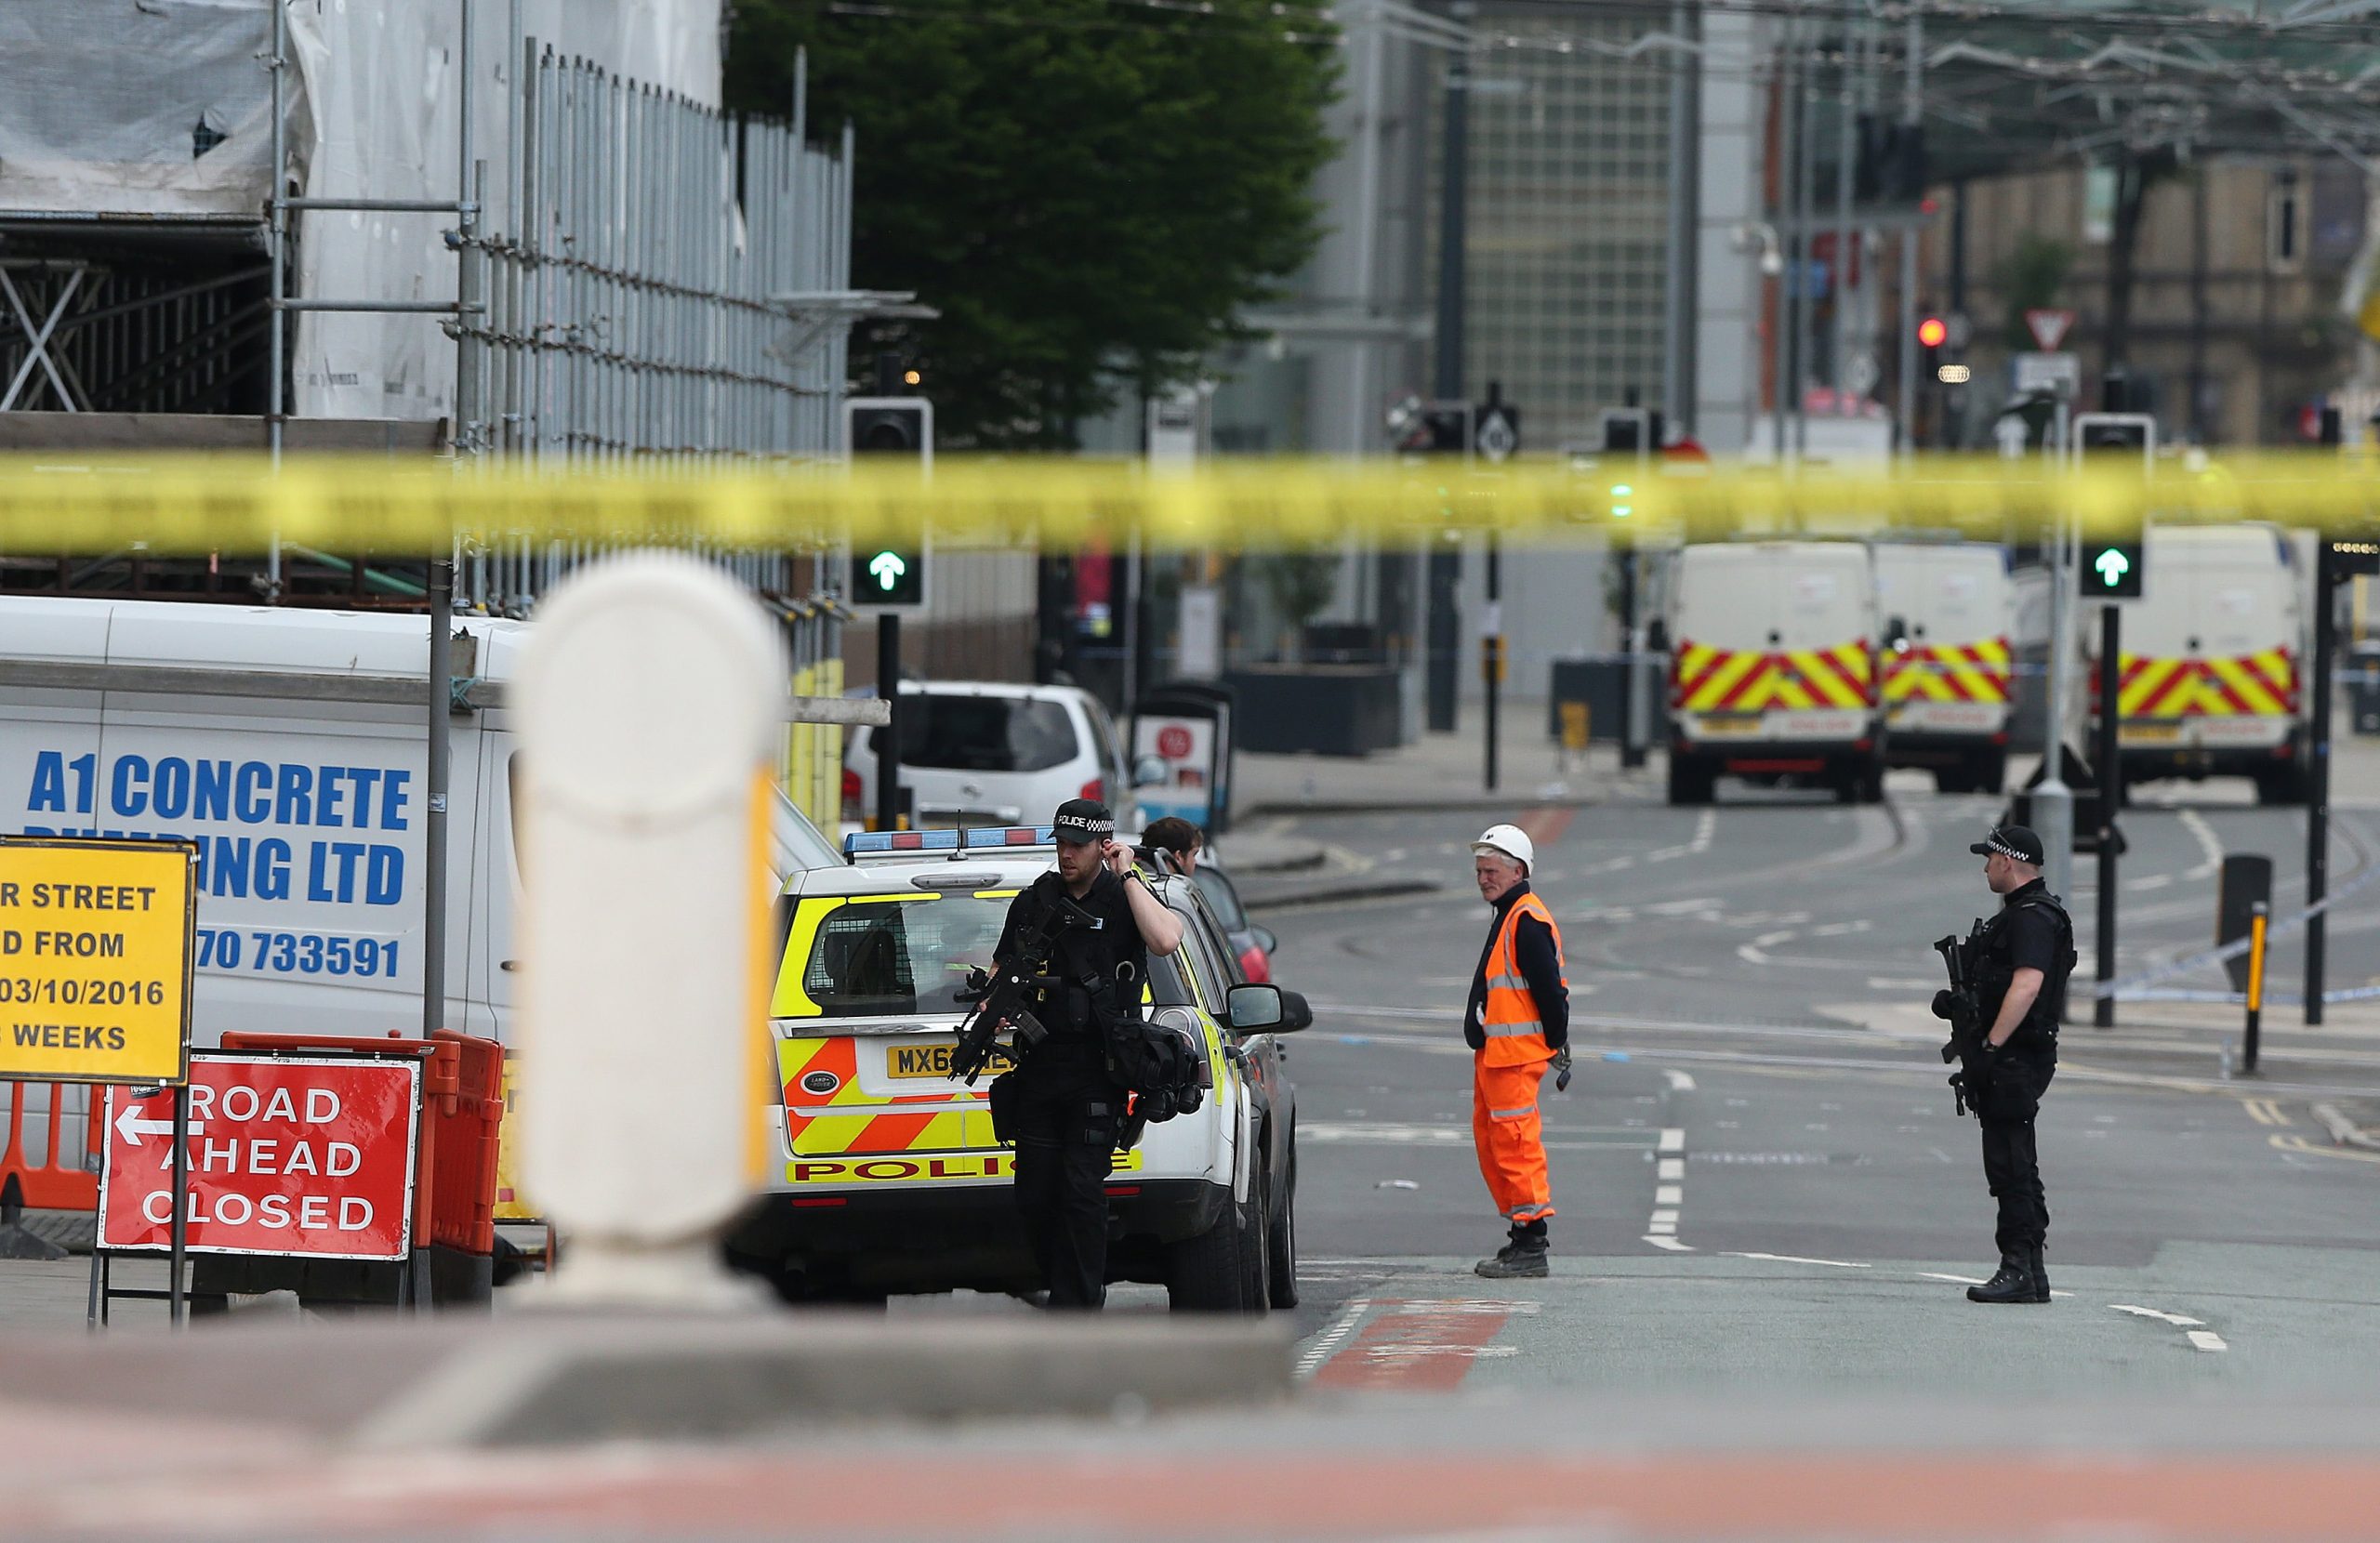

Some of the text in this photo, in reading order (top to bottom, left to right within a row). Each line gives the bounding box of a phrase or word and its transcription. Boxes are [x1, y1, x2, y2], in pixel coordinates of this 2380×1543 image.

[27, 750, 411, 831] A1 CONCRETE
[1057, 814, 1086, 828] POLICE
[307, 841, 405, 906] LTD
[32, 882, 156, 911] STREET
[34, 930, 124, 957] FROM
[252, 932, 399, 978] 733591
[0, 978, 164, 1006] 03/10/2016
[13, 1023, 126, 1050] WEEKS
[188, 1084, 341, 1124] ROAD
[160, 1138, 362, 1177] AHEAD
[795, 1152, 1132, 1181] POLI
[142, 1190, 374, 1231] CLOSED
